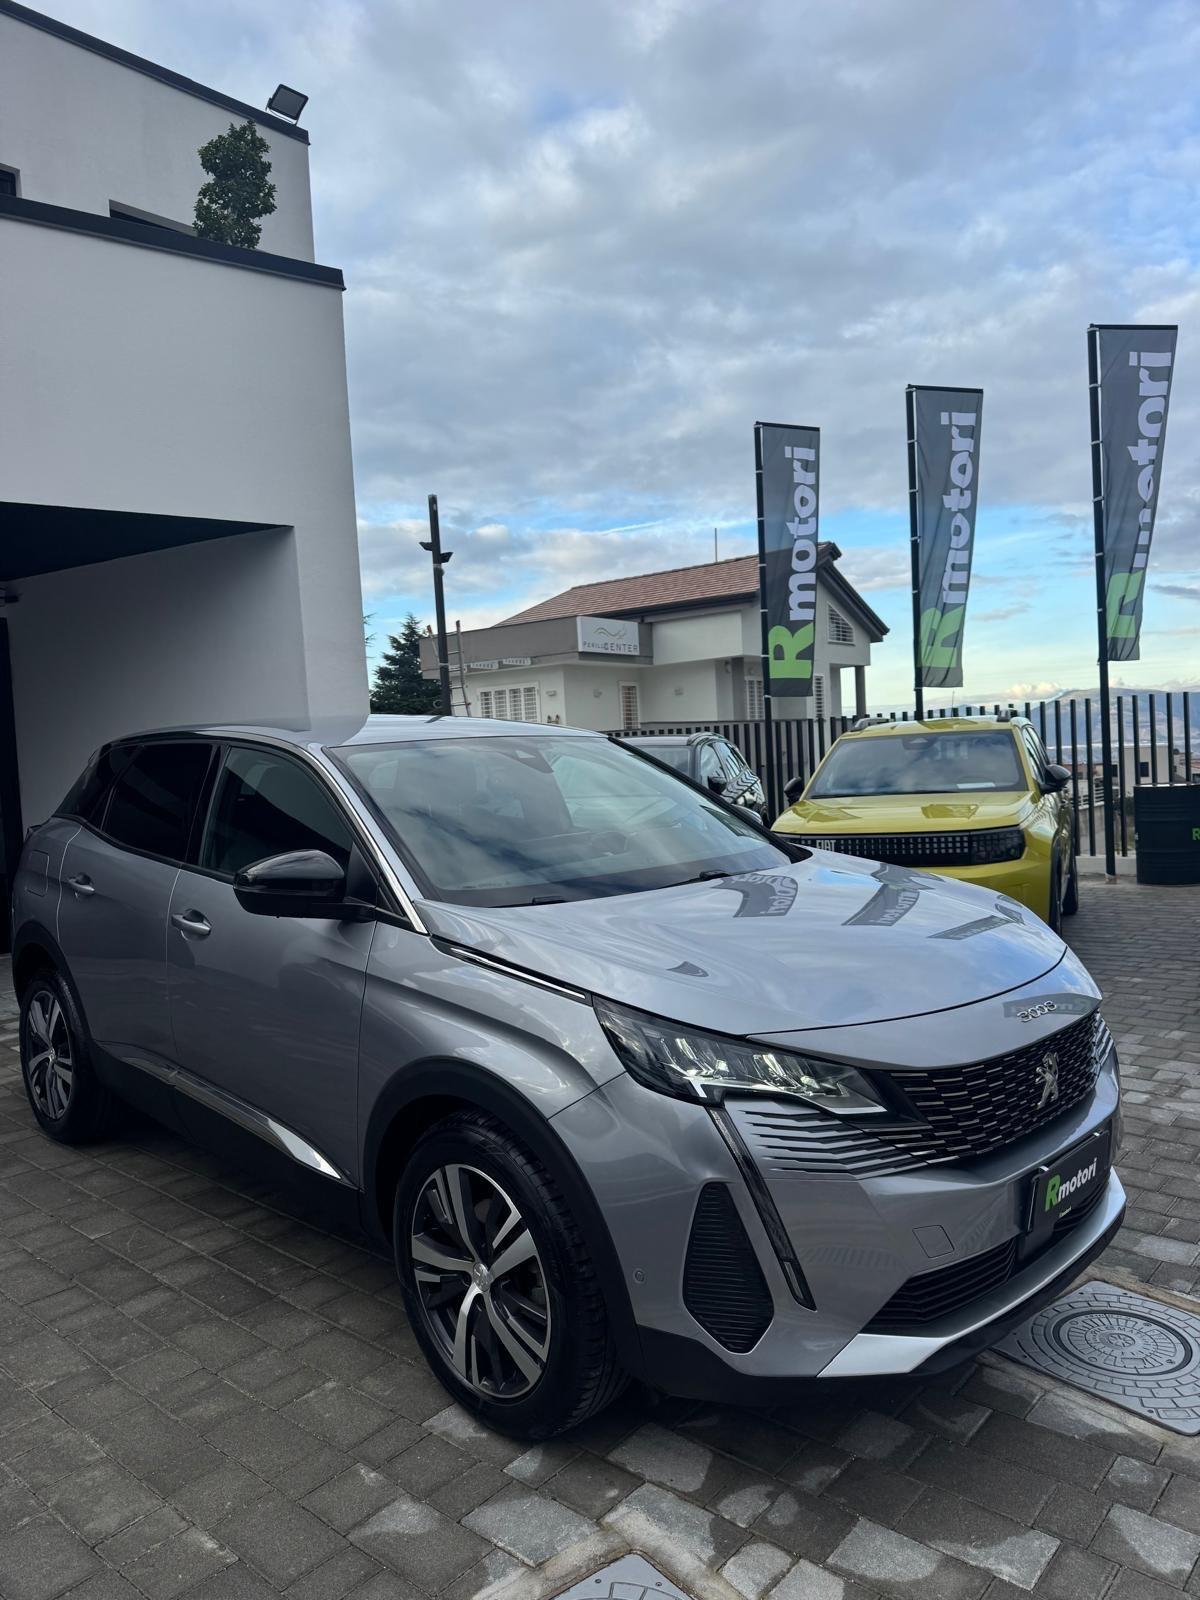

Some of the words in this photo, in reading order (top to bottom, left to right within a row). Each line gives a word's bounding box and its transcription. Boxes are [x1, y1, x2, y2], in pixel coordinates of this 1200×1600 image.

[768, 446, 817, 679] Rmotori
[917, 412, 977, 668] Rmotori
[816, 839, 836, 852] FIAT
[1044, 1157, 1098, 1212] Rmotori
